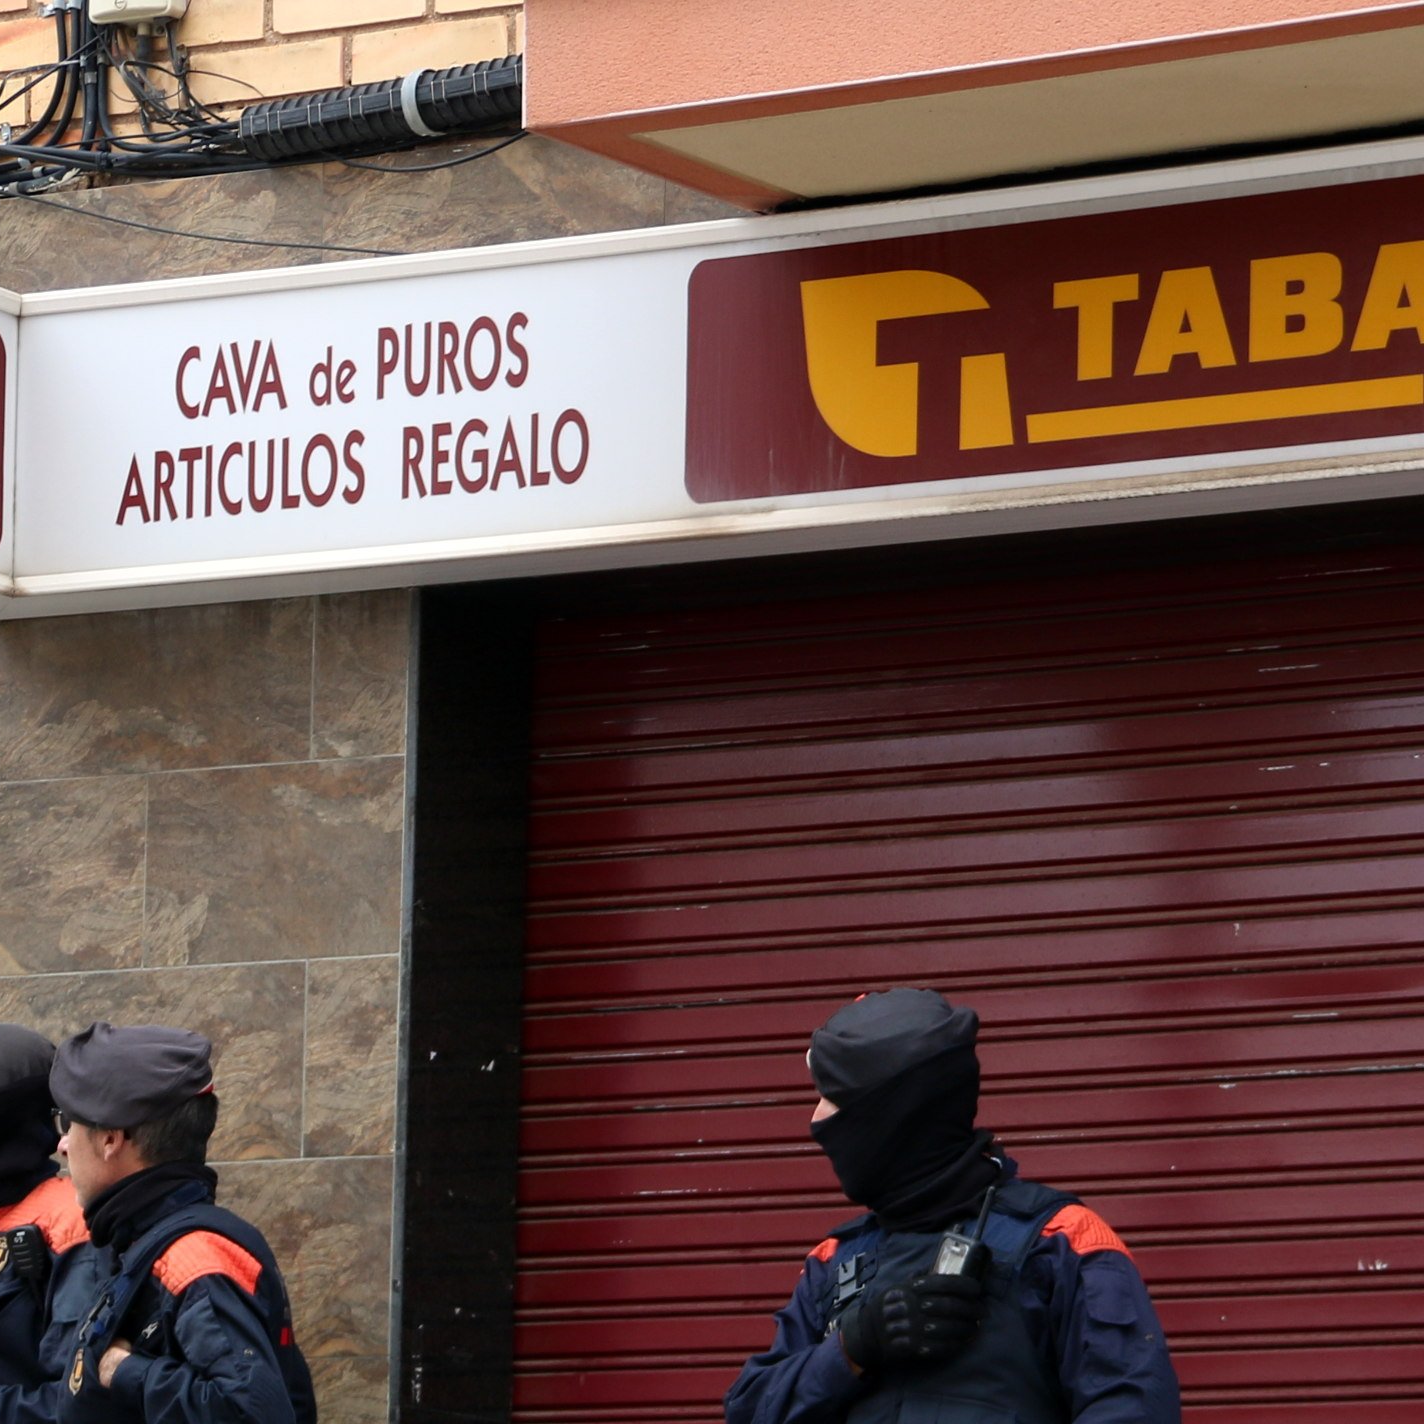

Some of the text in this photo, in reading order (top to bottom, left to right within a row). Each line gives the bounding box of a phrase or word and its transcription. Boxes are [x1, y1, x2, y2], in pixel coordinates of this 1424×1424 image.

[176, 312, 530, 419] CAVA de PUROS
[116, 408, 590, 526] ARTICULOS REGALO
